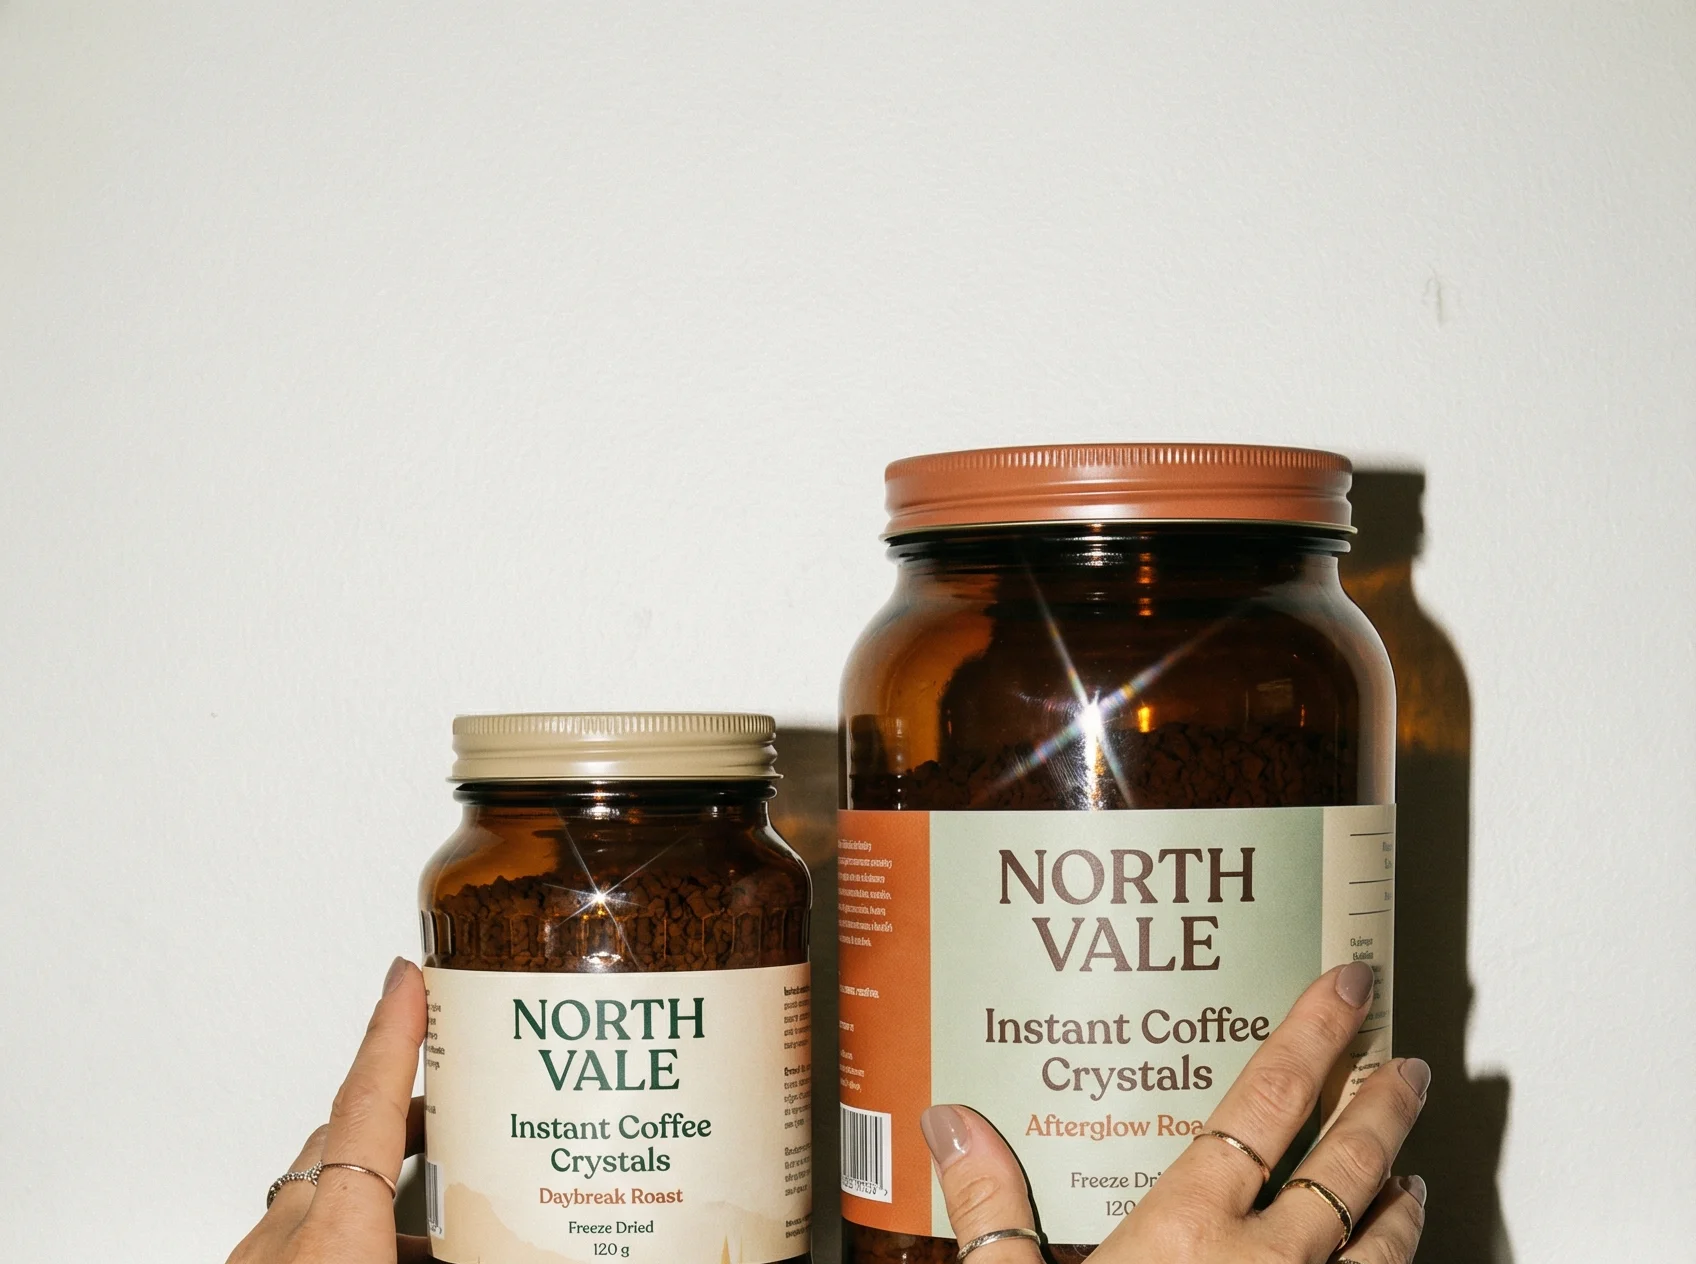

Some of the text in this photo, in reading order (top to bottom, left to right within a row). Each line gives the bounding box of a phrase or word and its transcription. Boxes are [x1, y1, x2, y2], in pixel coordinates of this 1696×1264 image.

[999, 847, 1256, 905] NORTH
[1032, 916, 1221, 972] VALE
[513, 998, 705, 1041] NORTH
[985, 1006, 1270, 1044] Instant Coffee
[538, 1049, 680, 1091] VALE
[1042, 1054, 1213, 1102] Crystals
[510, 1113, 712, 1140] Instant Coffee
[1025, 1114, 1204, 1142] Afterglow Roa
[550, 1147, 671, 1179] Crystals
[1071, 1172, 1129, 1189] Freeze
[539, 1188, 684, 1209] Daybreak Roast
[1106, 1200, 1136, 1216] 120
[568, 1220, 654, 1234] Freeze Dried
[594, 1243, 630, 1257] 120 g
